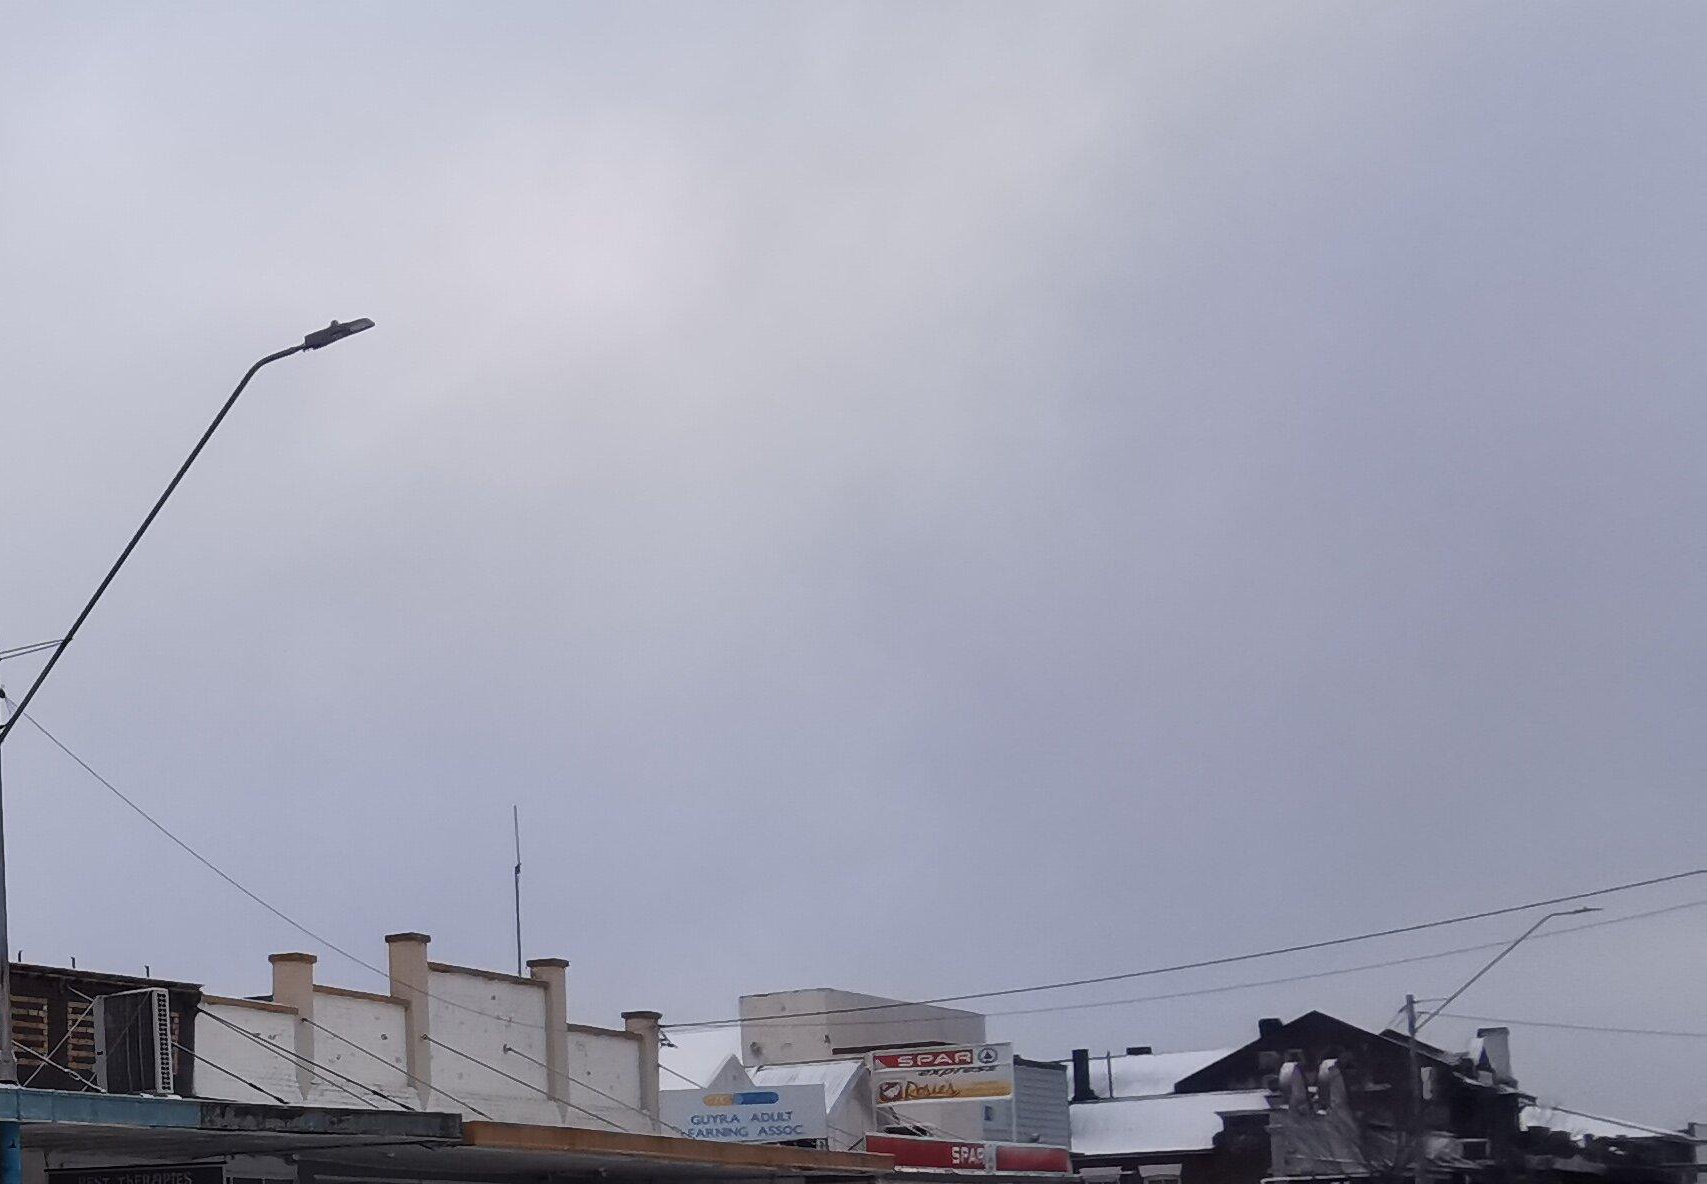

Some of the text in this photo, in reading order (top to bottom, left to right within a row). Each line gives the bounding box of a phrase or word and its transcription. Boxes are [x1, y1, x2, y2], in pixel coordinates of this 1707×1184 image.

[897, 1051, 972, 1067] SPAR
[917, 1065, 998, 1078] express
[690, 1111, 793, 1126] GUYRA ADULT
[682, 1126, 749, 1139] EARNING
